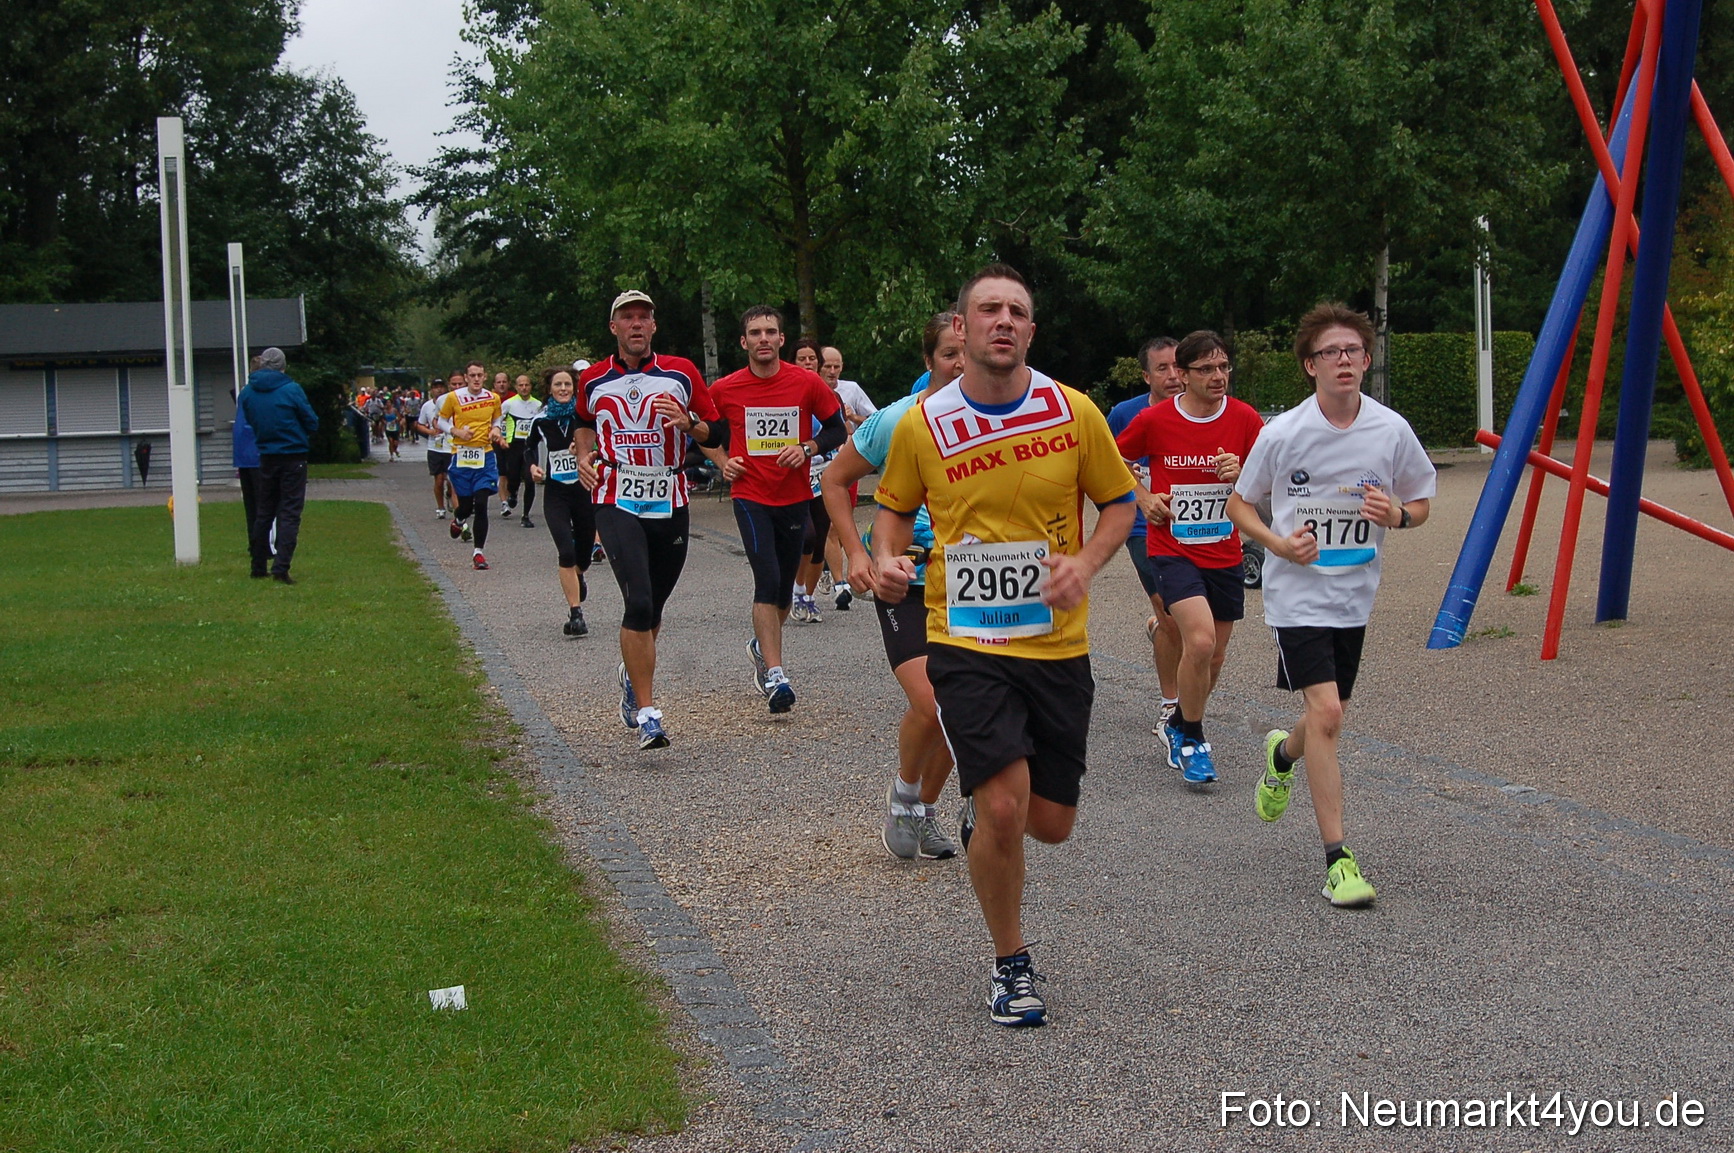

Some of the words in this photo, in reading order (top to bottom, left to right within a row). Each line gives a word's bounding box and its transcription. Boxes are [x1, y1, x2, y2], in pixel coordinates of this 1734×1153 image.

[756, 418, 790, 437] 324
[614, 432, 661, 445] BIMBO
[760, 440, 786, 449] Florian
[462, 450, 480, 460] 486
[945, 450, 1008, 484] MAX
[1012, 432, 1080, 462] BÖGL
[1164, 455, 1240, 466] NEUMAR
[618, 469, 637, 477] PARTL
[622, 478, 668, 498] 2513
[1177, 498, 1228, 522] 2377
[1296, 508, 1324, 516] PARTL
[1326, 508, 1362, 516] Neumark
[1187, 526, 1219, 536] Gerhard
[946, 552, 980, 564] PARTL
[981, 551, 1031, 562] Neumarkt
[956, 564, 1041, 602] 2962
[978, 610, 1020, 626] Julian
